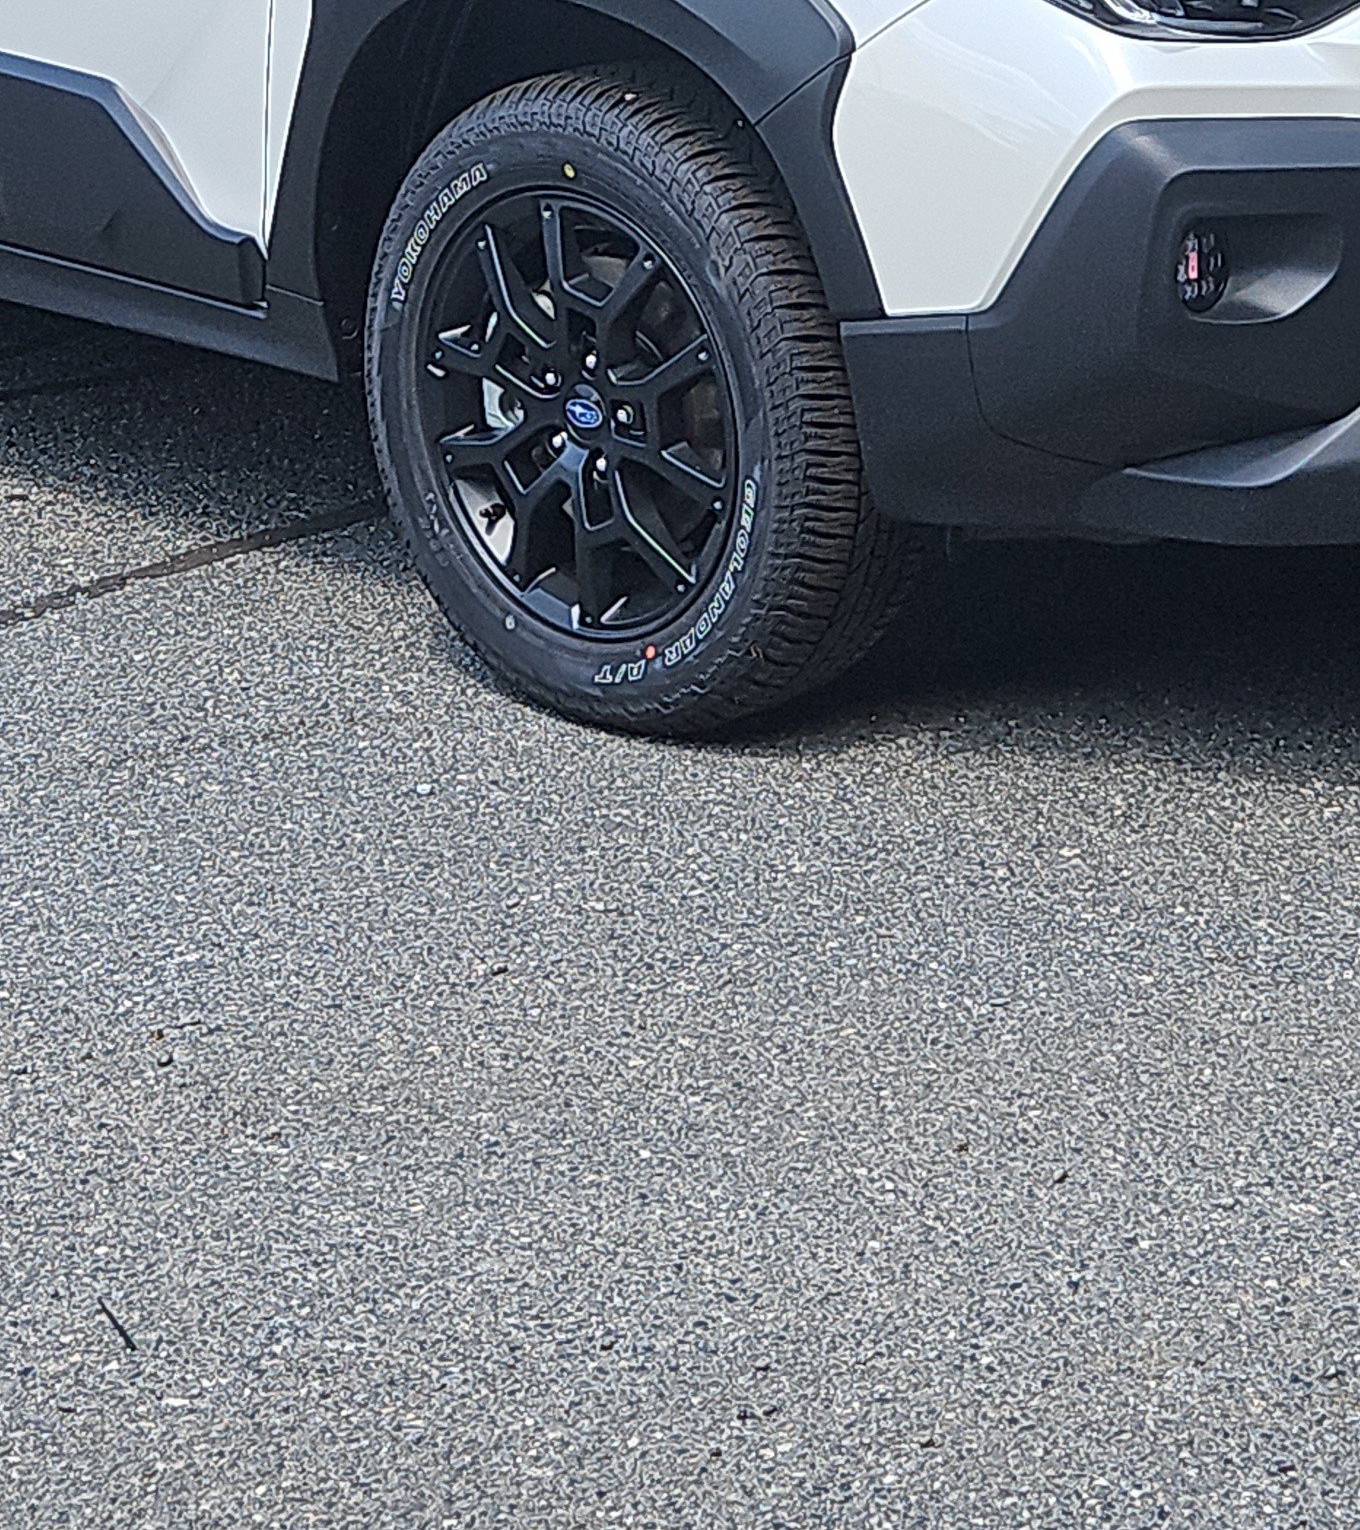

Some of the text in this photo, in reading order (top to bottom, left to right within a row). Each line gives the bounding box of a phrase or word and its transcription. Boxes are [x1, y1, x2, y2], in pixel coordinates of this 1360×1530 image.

[391, 162, 488, 301] YOKOHAMA
[663, 479, 756, 667] GEOLANDAR
[594, 658, 648, 684] A/T
